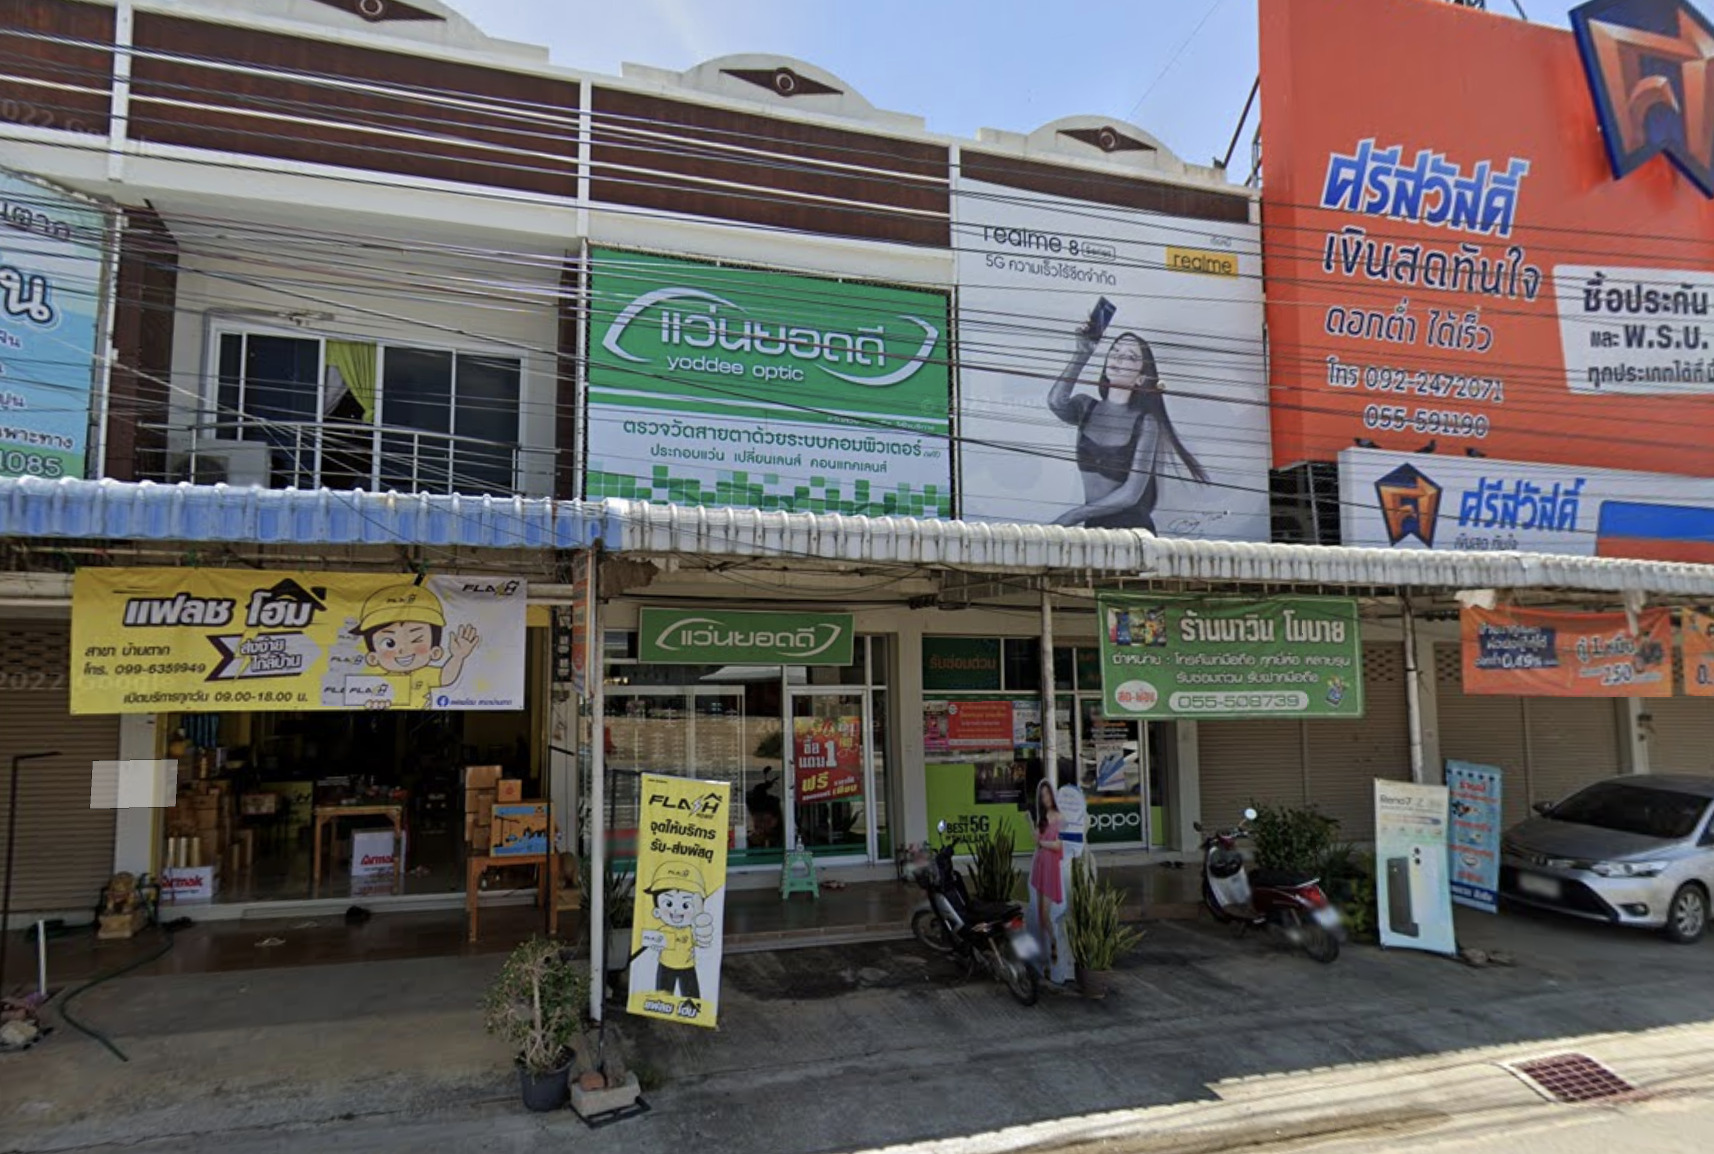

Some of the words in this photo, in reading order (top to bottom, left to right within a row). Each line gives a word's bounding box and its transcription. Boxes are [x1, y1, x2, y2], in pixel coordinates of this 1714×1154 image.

[1321, 138, 1530, 238] ศรีสวัสดิ์
[983, 226, 1062, 252] realme
[1068, 240, 1079, 256] 8
[986, 254, 1006, 270] 5G
[1009, 259, 1117, 286] ความเร็วไร้ขีดจำกัด
[1174, 253, 1232, 275] realme
[1323, 226, 1542, 300] เงินสดทันใจ
[1583, 271, 1708, 315] ซื้อประกัน
[661, 304, 886, 367] แว่นยอดดี
[1326, 298, 1417, 344] ดอกต่ำ
[1427, 306, 1493, 352] ได้เร็ว
[1590, 331, 1619, 347] และ
[1625, 324, 1709, 350] พ.ร.บ.
[667, 355, 745, 376] yoddee
[752, 362, 804, 382] optic
[1327, 356, 1359, 386] โทร
[1365, 366, 1504, 401] 092-2472071
[623, 419, 922, 457] ตรวจวัดสายตาด้วยระบบคอมพิวเตอร์
[650, 444, 726, 462] ประกอบแว่น
[734, 447, 803, 467] เปลี่ยนเลนส์
[810, 455, 888, 474] คอนแทคเลนส์
[1458, 476, 1587, 532] ศรีสวัสดิ์
[123, 592, 235, 627] แฟลช
[246, 590, 313, 627] โฮม
[681, 626, 815, 648] แว่นยอดดี
[1180, 609, 1275, 643] ร้านนาวิน
[1283, 609, 1346, 643] โมบาย
[85, 646, 116, 657] สาขา
[122, 642, 170, 656] บ้านตาก
[1112, 653, 1162, 665] จำหน่าย
[84, 662, 108, 675] โทร.
[123, 692, 210, 705] เปิดบริการทุกวัน
[214, 691, 293, 702] 09.00-18.00
[824, 740, 837, 769] 1
[802, 771, 829, 792] ฟรี
[650, 818, 716, 841] จุดให้บริการ
[947, 823, 968, 833] BEST
[970, 815, 989, 832] 5G
[361, 854, 395, 865] Arma
[650, 839, 715, 864] รับ-ส่งพัสดุ
